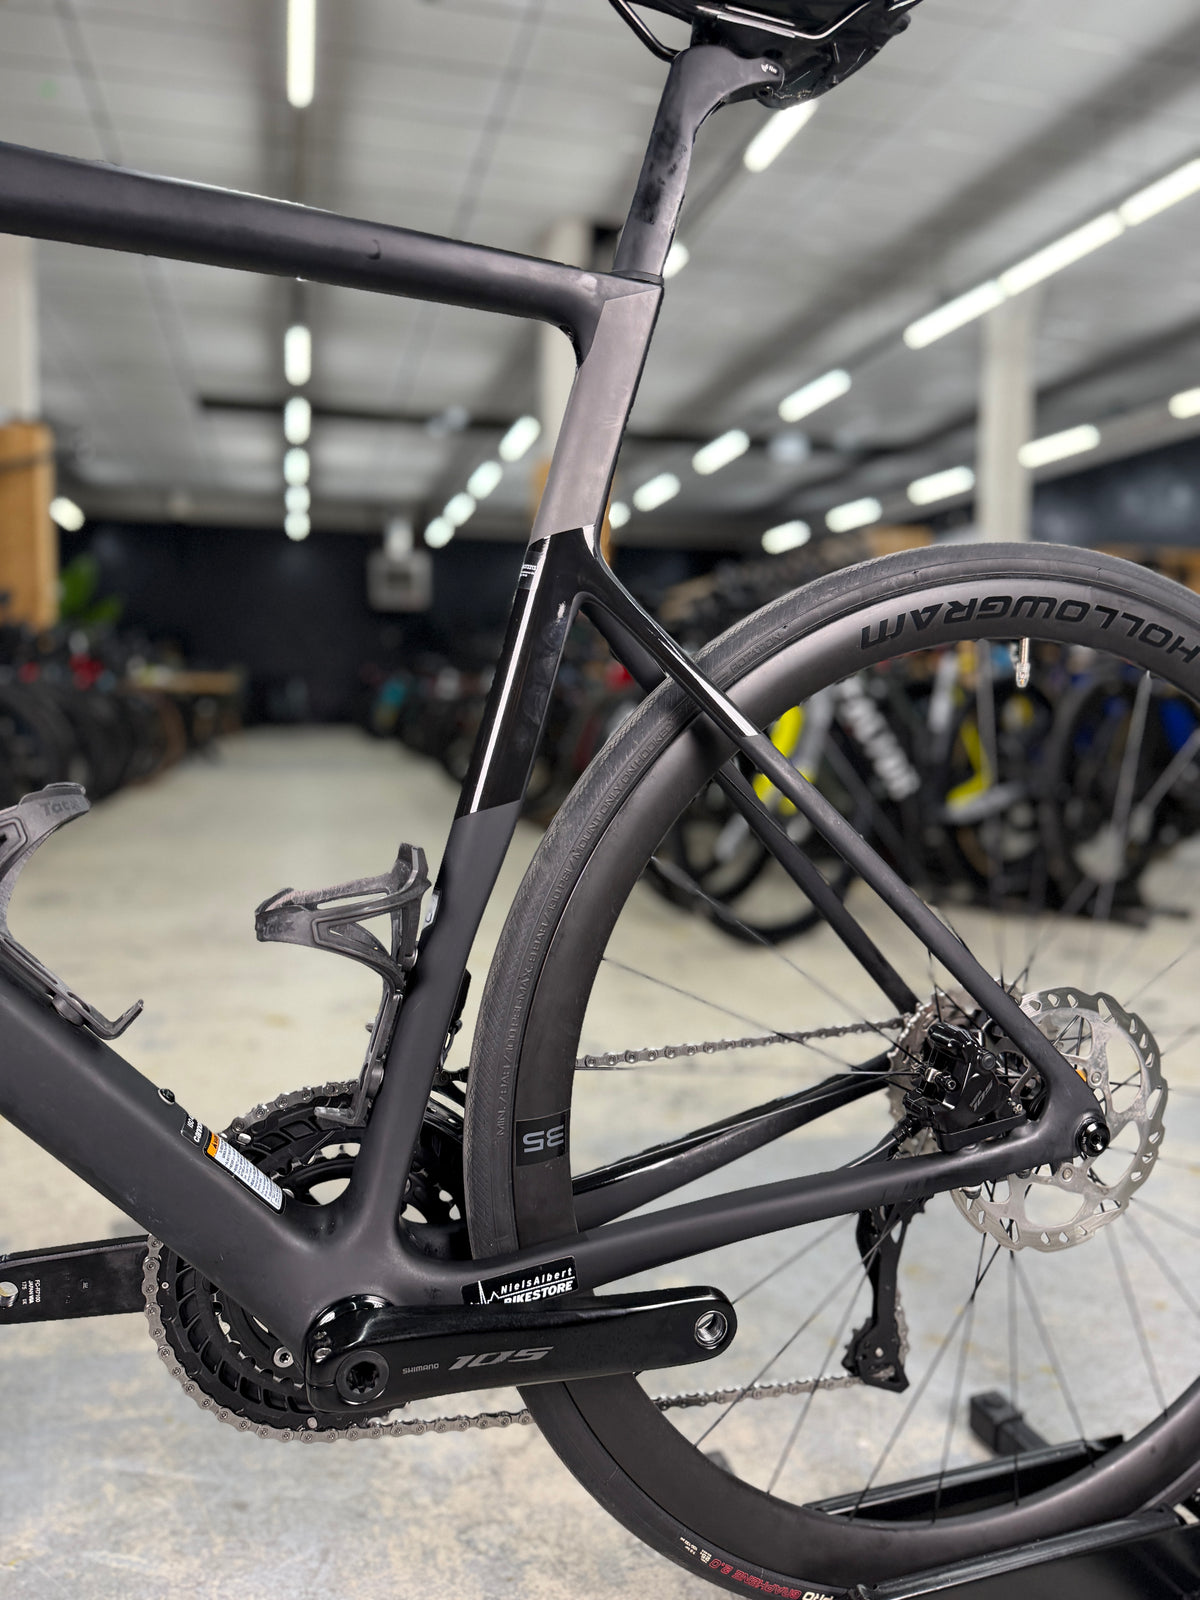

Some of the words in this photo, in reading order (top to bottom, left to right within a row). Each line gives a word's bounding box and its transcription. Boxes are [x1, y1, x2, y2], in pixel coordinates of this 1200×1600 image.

[860, 596, 1200, 664] HOLLOWGRAM
[402, 1363, 439, 1375] SHIMANO
[448, 1346, 554, 1371] 105
